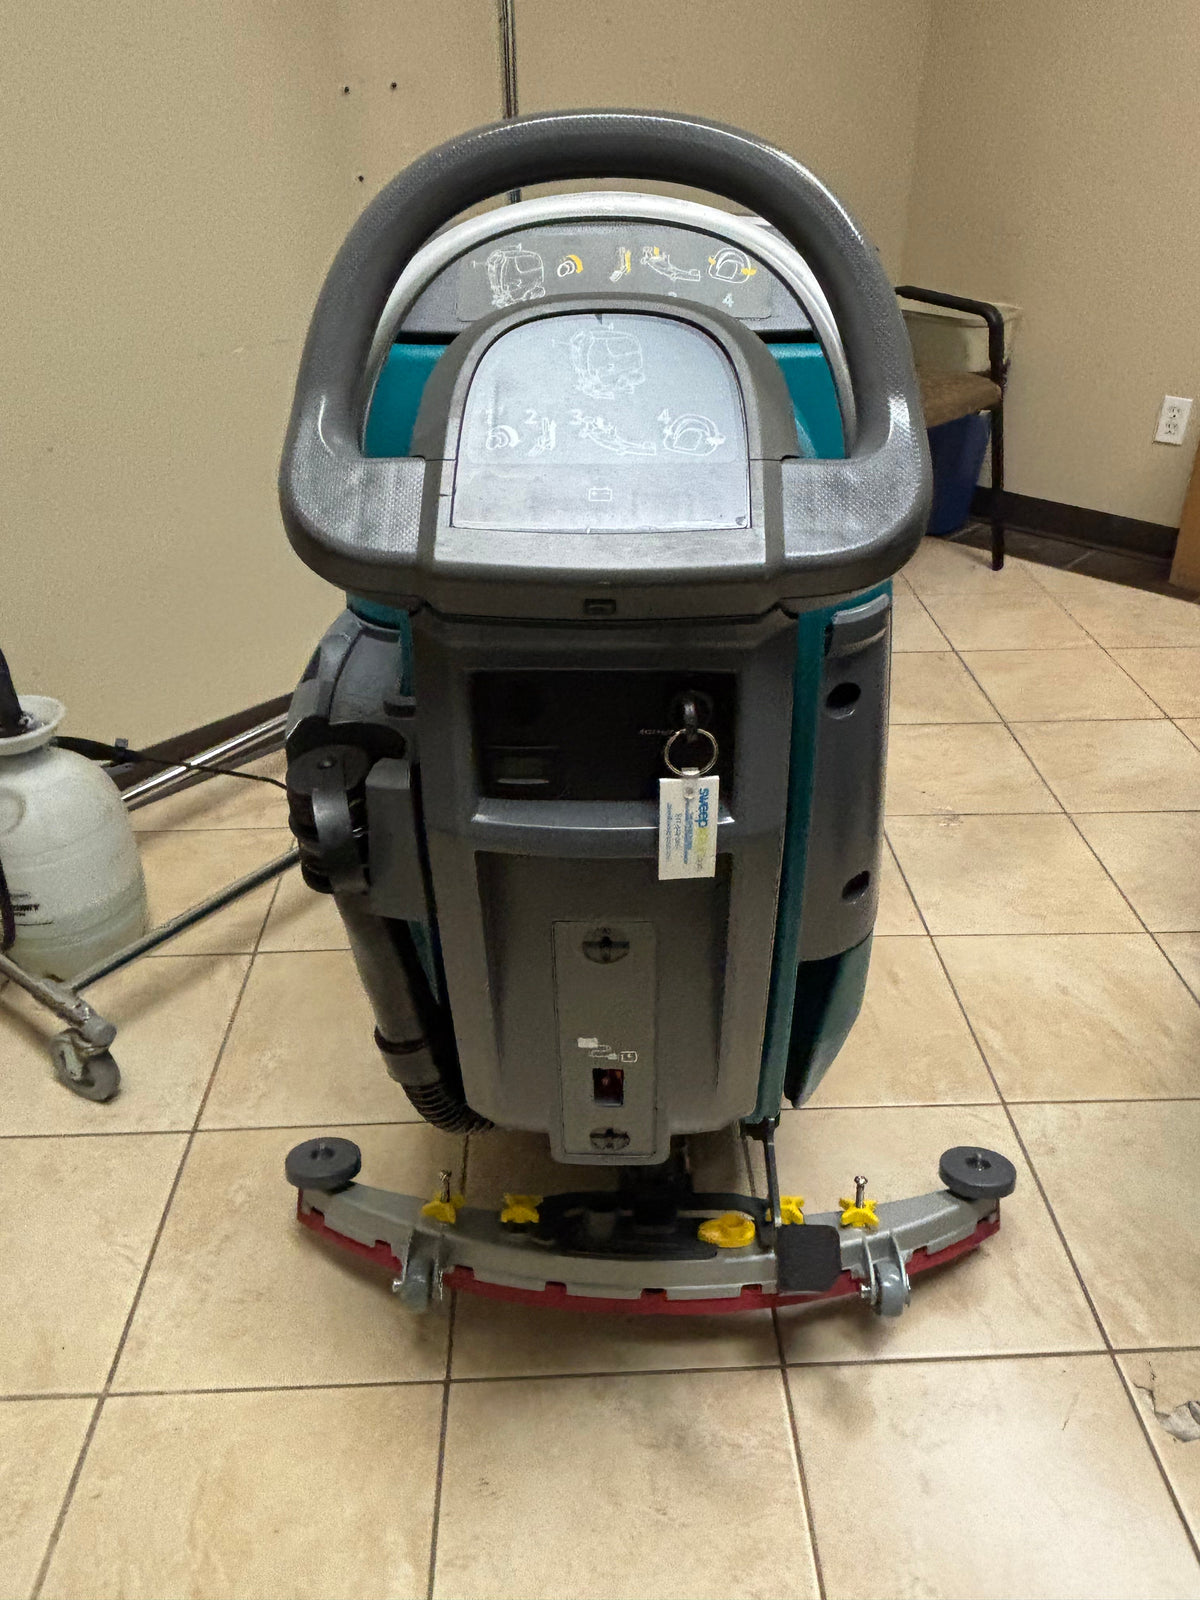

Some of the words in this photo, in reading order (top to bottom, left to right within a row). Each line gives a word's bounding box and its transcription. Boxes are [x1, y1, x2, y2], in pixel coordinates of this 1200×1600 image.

[722, 293, 734, 307] 4
[524, 409, 538, 424] 2
[570, 409, 583, 425] 3
[657, 408, 671, 424] 4
[695, 788, 709, 828] sweep
